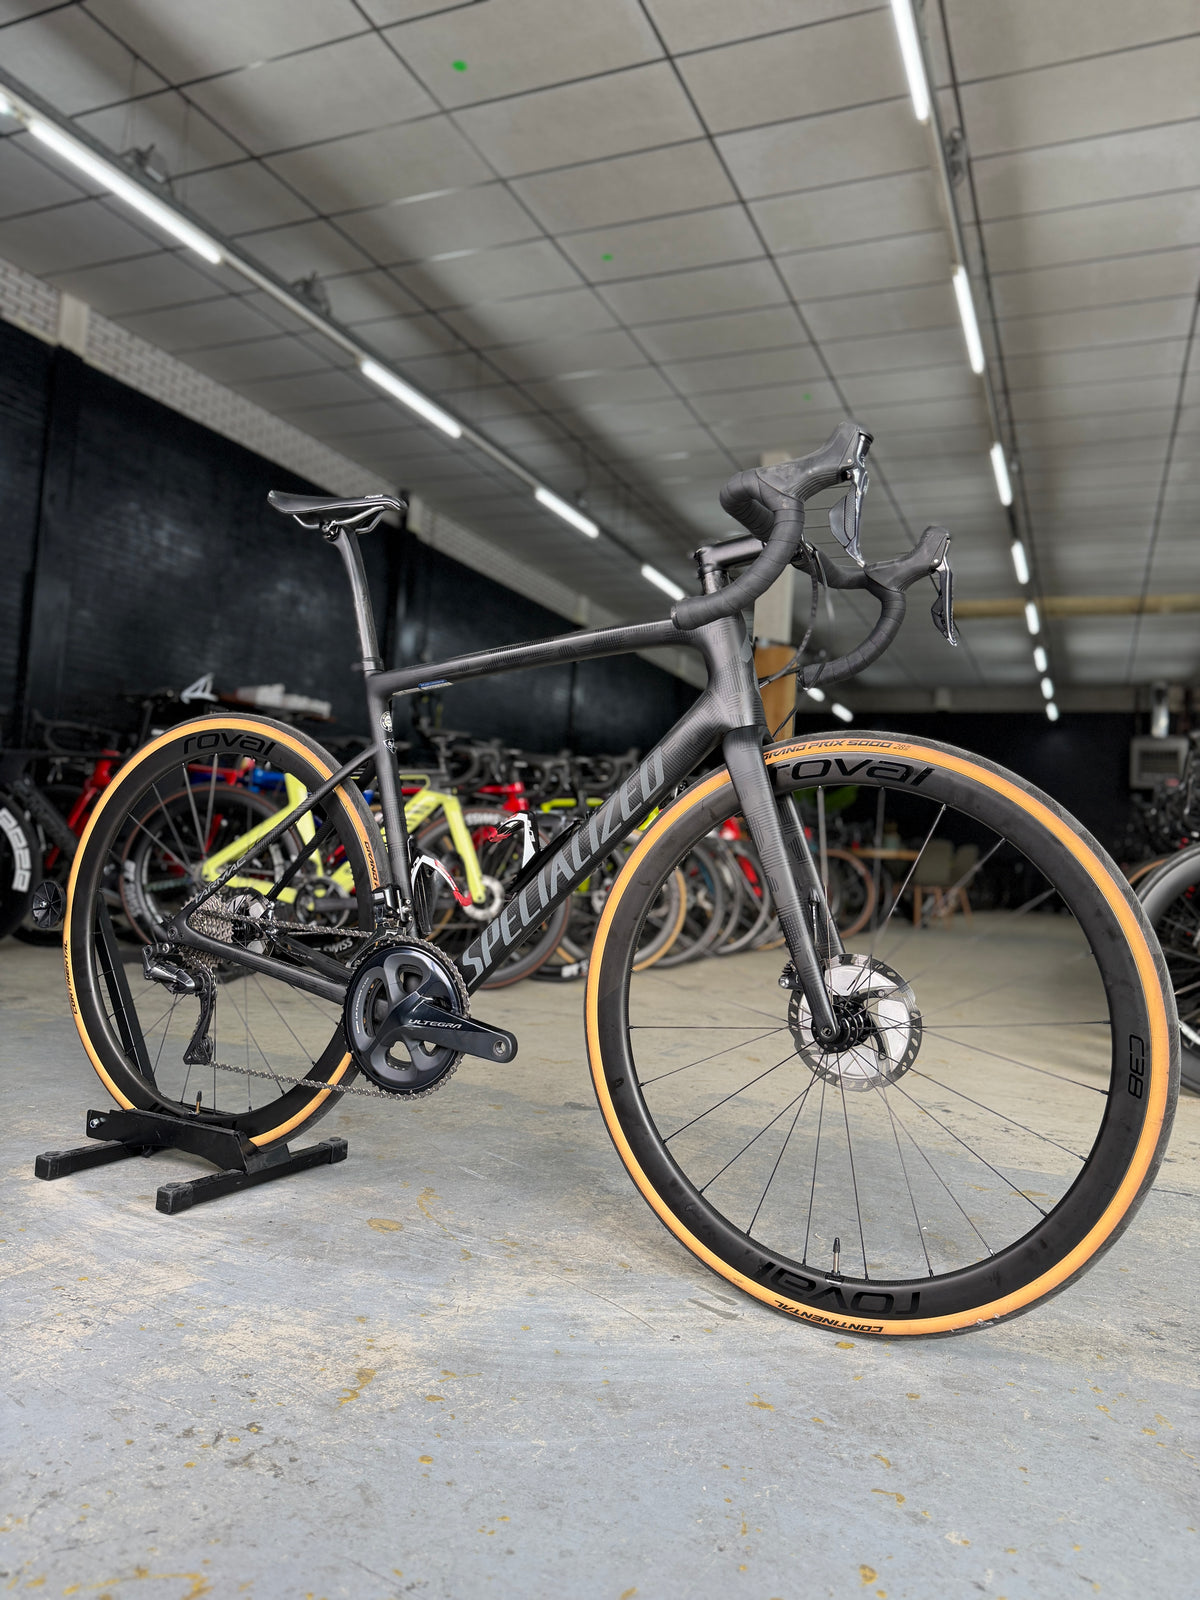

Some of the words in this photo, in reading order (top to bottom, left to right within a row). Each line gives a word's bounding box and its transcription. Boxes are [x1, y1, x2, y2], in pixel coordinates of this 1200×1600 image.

[184, 732, 277, 756] roval
[763, 744, 806, 760] GRAND
[808, 740, 845, 749] PRIX
[847, 739, 893, 749] 5000
[769, 758, 936, 789] roval
[195, 855, 247, 903] TARMAC
[462, 746, 665, 988] SPECIALIZED
[63, 940, 78, 1015] CONTINENTAL
[407, 1018, 463, 1029] ULTEGRA
[1128, 1034, 1144, 1100] C38
[753, 1261, 921, 1315] roval
[774, 1299, 884, 1333] CONTINENTAL
